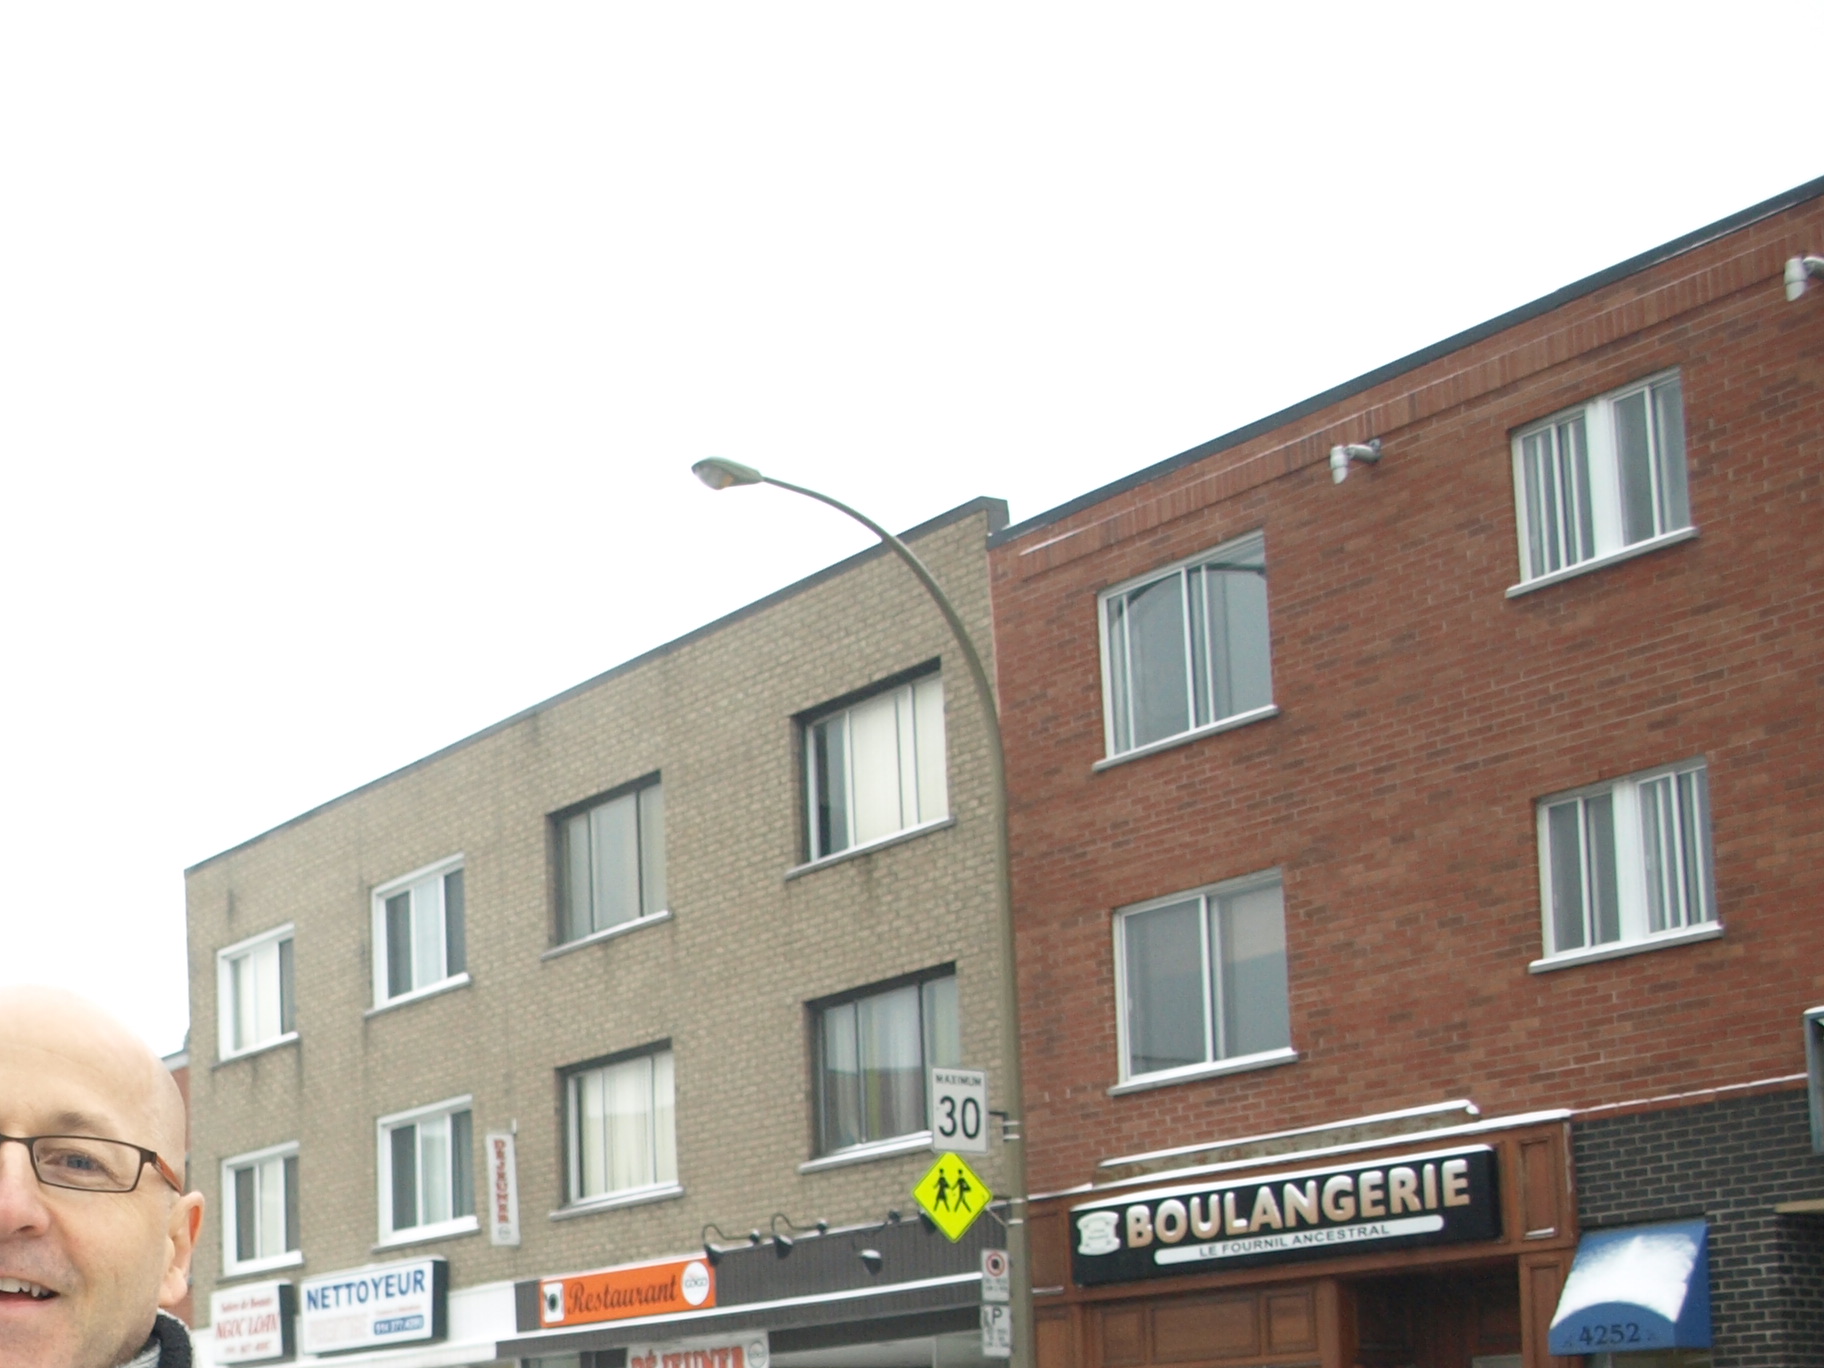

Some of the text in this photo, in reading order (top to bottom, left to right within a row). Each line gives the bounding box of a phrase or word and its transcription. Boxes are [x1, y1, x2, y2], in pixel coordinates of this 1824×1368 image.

[936, 1073, 981, 1086] MAXIMUM
[939, 1095, 980, 1139] 30
[1127, 1159, 1470, 1249] BOULANGERIE
[1199, 1224, 1390, 1258] LE FOURNIL ANCESTRAL
[307, 1269, 425, 1311] NETTOYEUR
[567, 1274, 676, 1315] Restaurant
[1580, 1323, 1640, 1346] 4252
